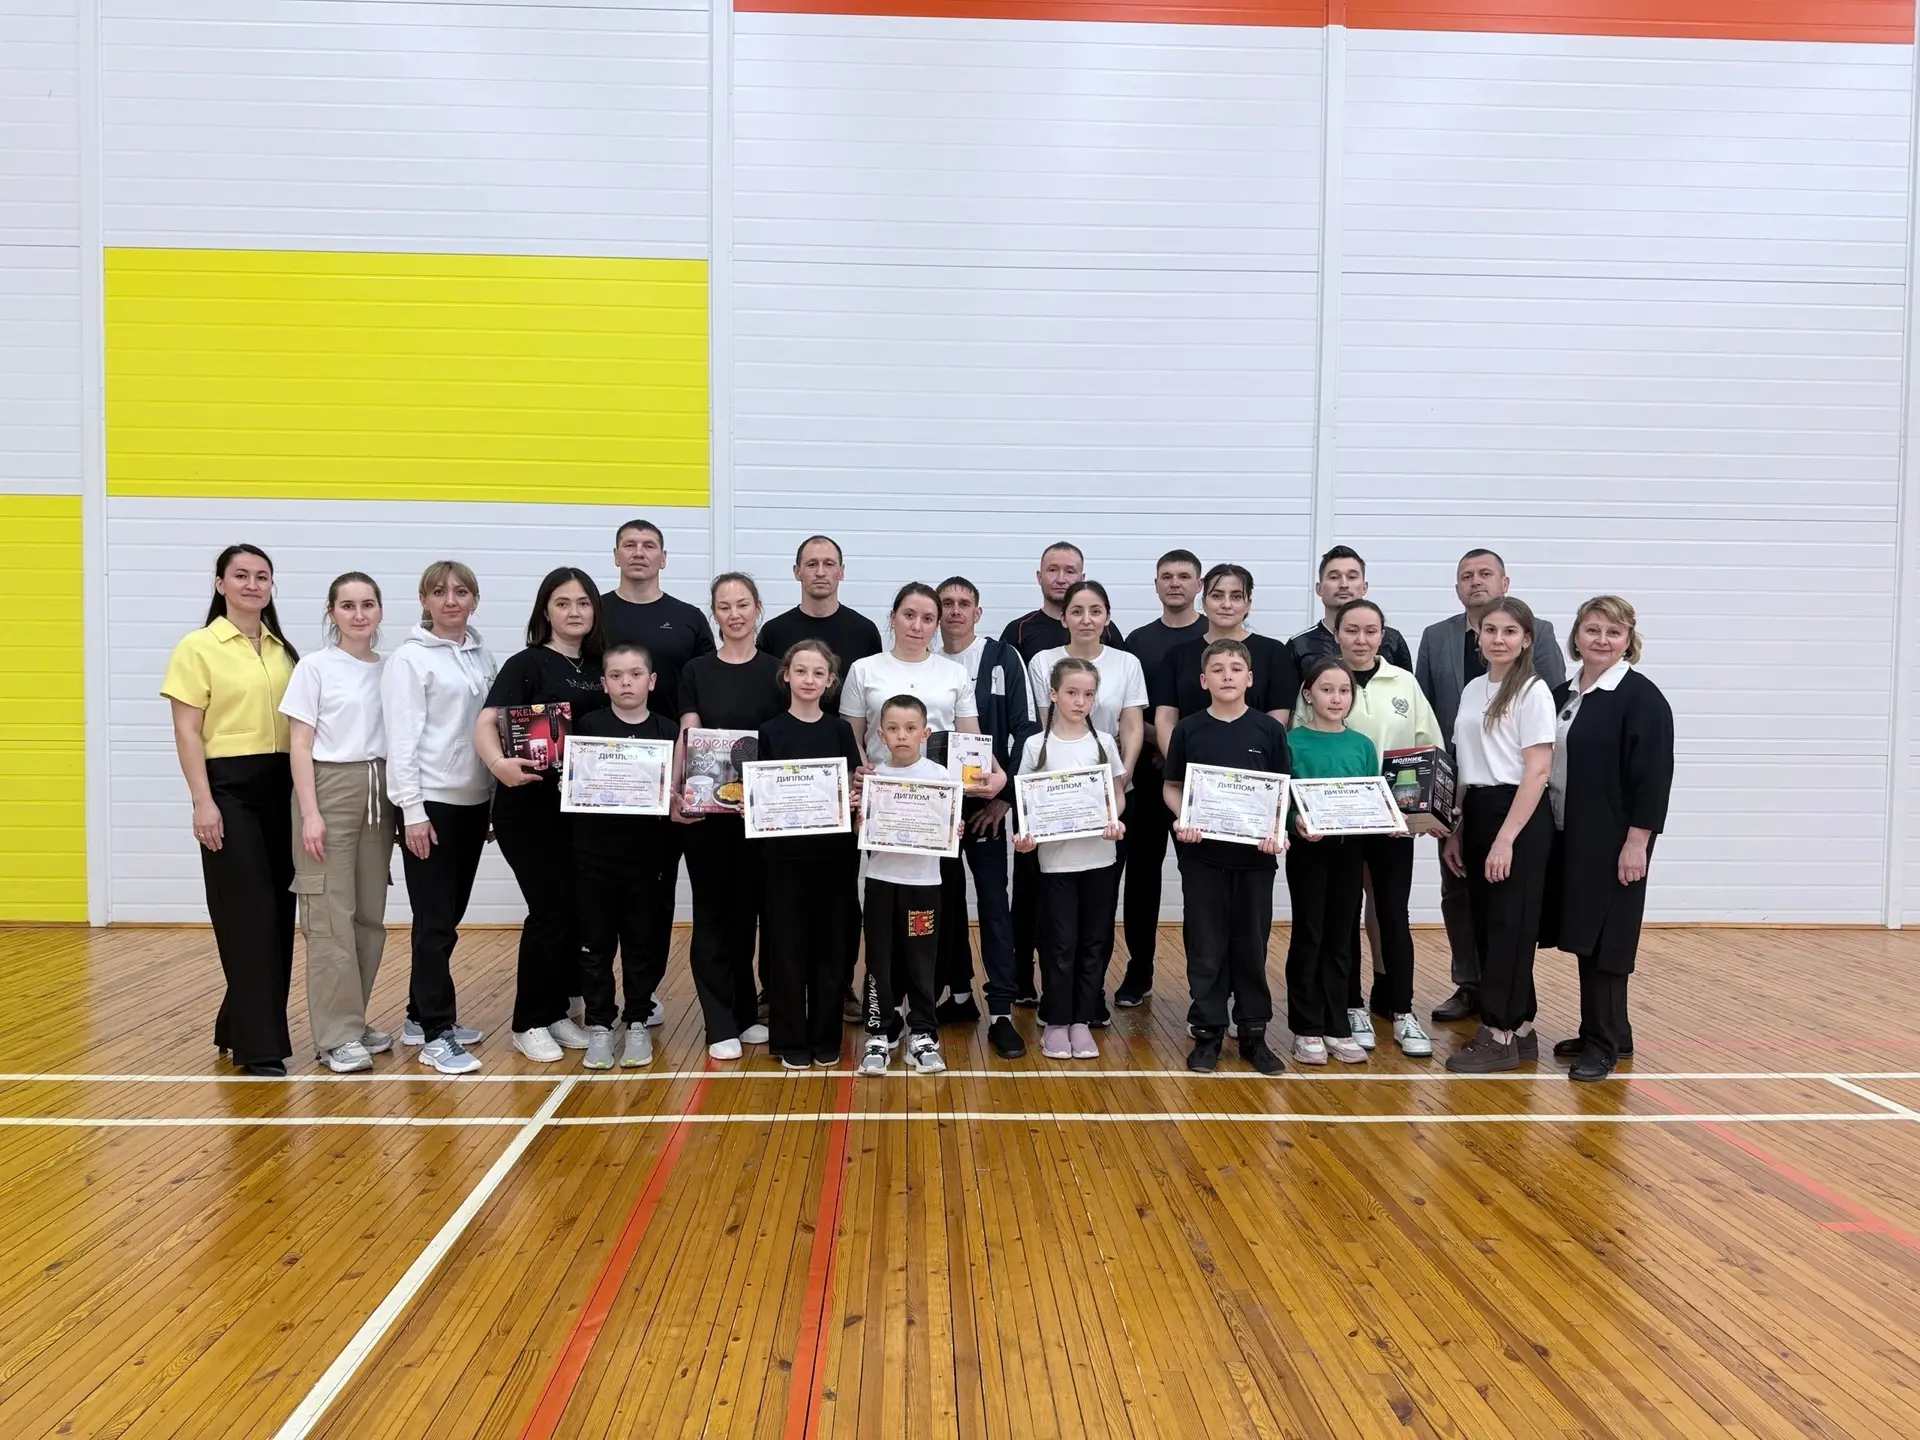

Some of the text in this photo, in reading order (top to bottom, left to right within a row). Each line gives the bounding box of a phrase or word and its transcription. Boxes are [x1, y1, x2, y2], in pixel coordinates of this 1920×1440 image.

[598, 753, 639, 761] ДИПЛОМ
[1392, 756, 1422, 764] МОЛНИЯ
[776, 775, 814, 783] ДИПЛОМ
[1046, 782, 1082, 792] ДИПЛОМ
[1217, 782, 1256, 792] ДИПЛОМ
[893, 792, 930, 801] ДИПЛОМ
